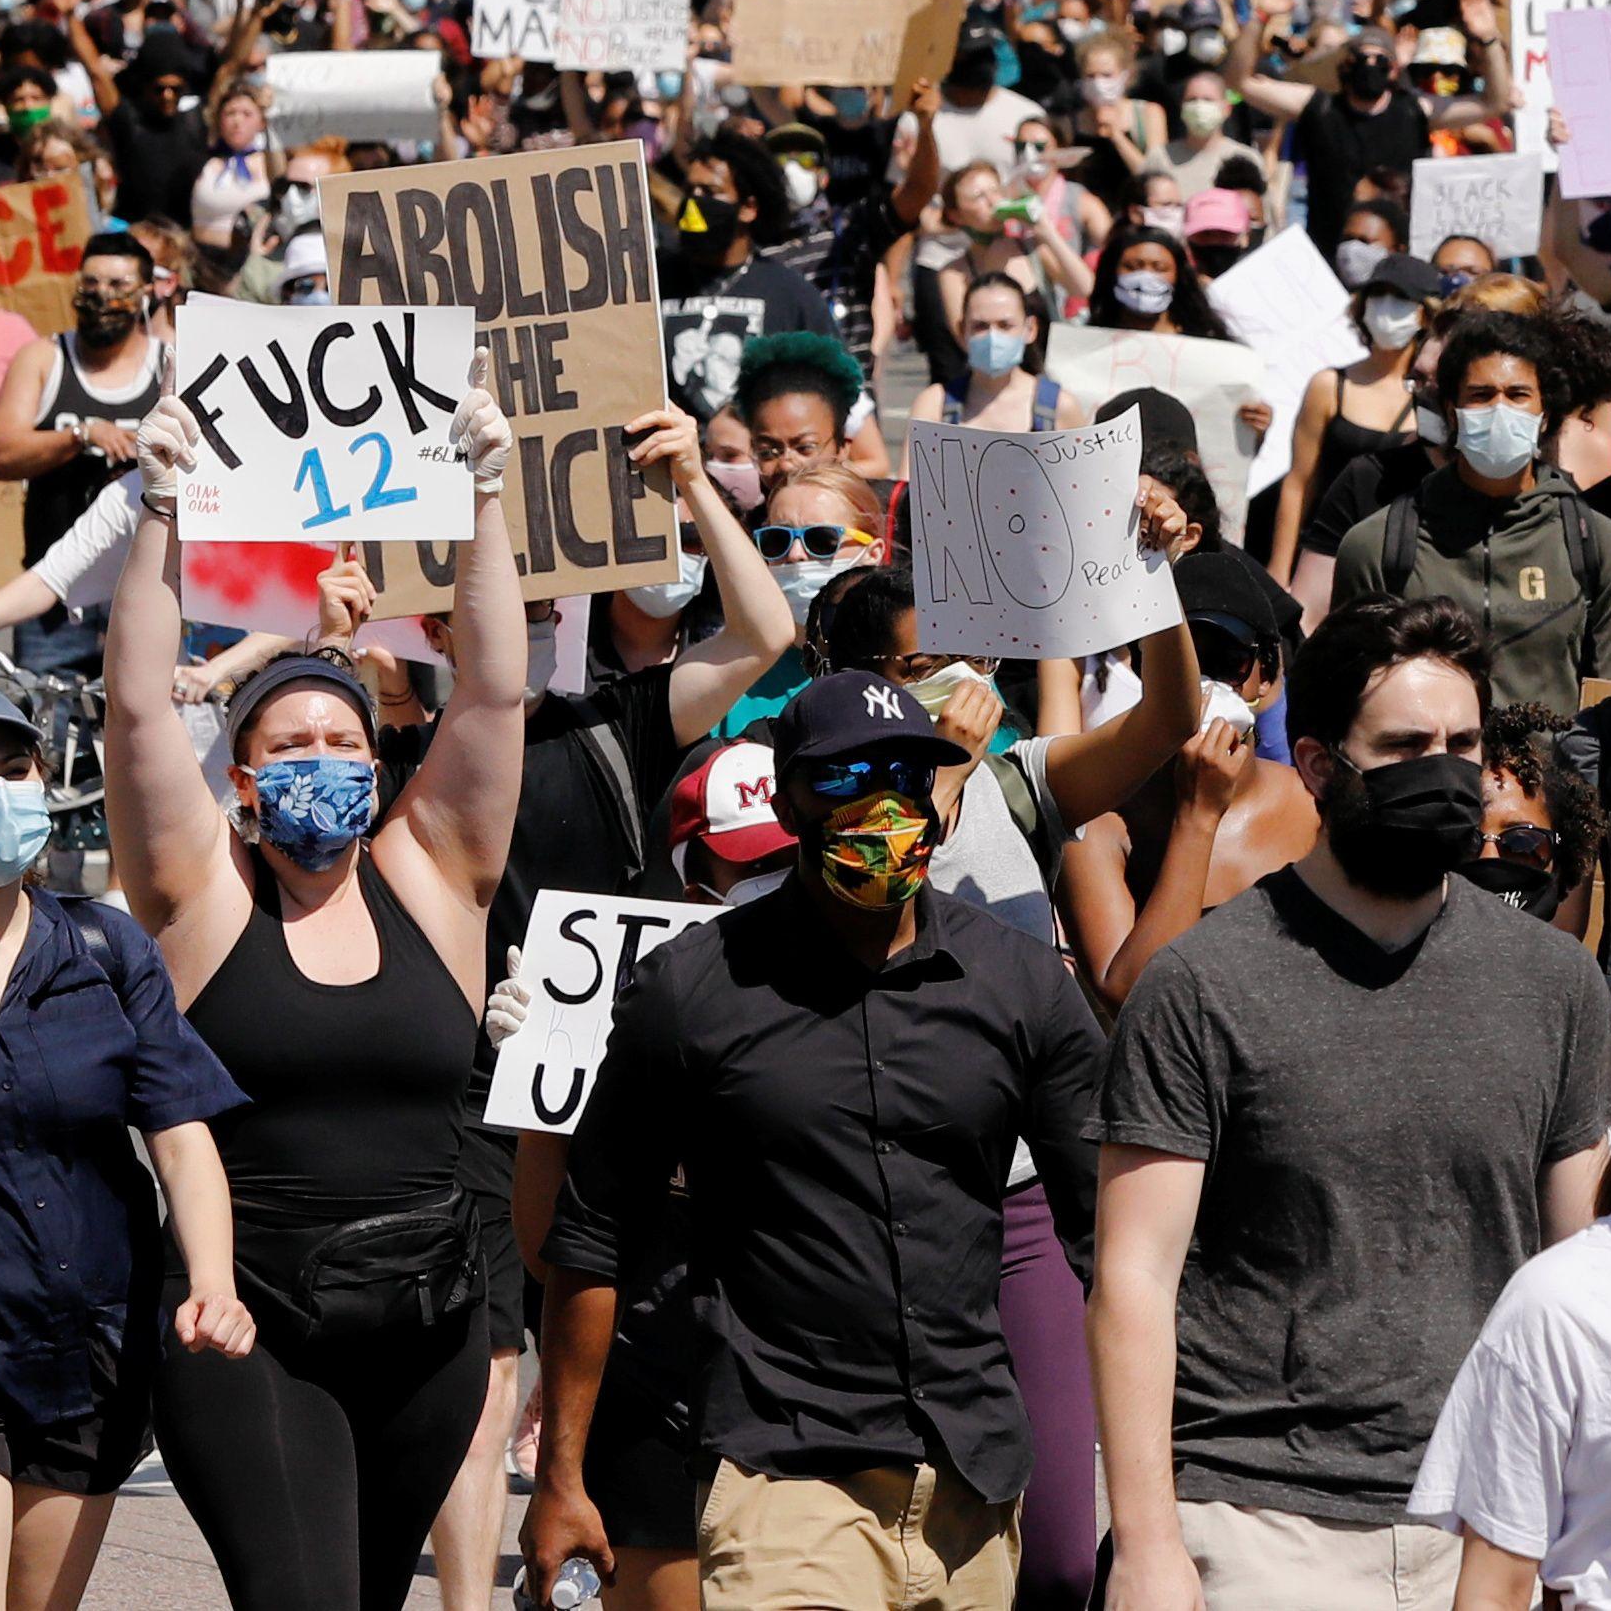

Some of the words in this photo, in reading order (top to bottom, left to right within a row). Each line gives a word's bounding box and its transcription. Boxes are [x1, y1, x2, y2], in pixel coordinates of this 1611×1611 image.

[338, 162, 651, 322] ABOLISH
[178, 311, 460, 472] FUCK
[185, 482, 221, 499] OINK
[187, 499, 221, 514] OINK
[292, 430, 418, 530] 12
[914, 437, 1075, 610] NO
[1518, 565, 1547, 602] G
